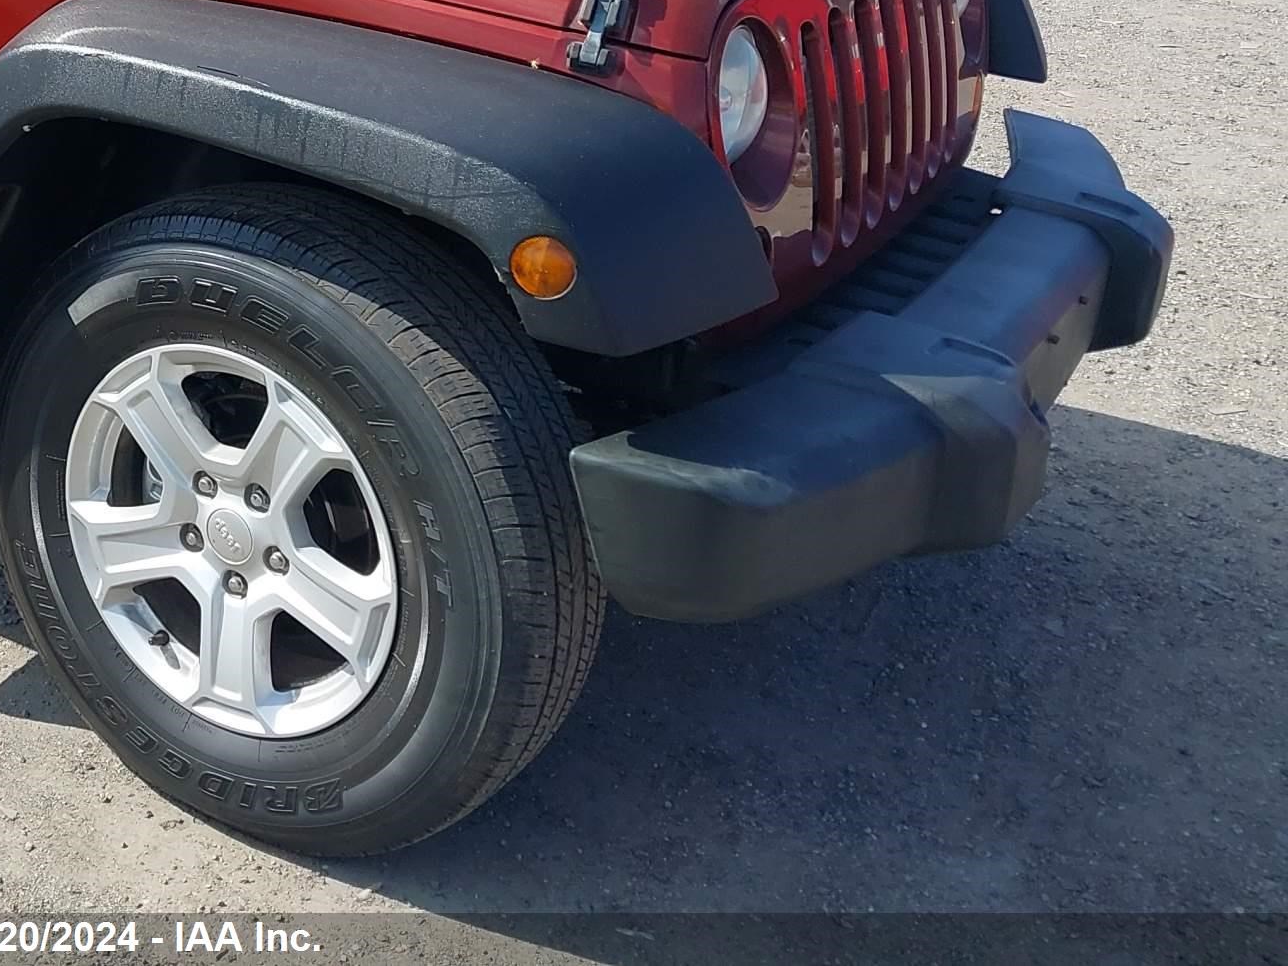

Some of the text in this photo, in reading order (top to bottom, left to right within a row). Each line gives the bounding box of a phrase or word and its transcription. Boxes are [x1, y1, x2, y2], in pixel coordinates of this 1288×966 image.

[135, 275, 420, 479] DUELER
[412, 499, 454, 609] H/T
[15, 540, 348, 815] BRIDGESTONE
